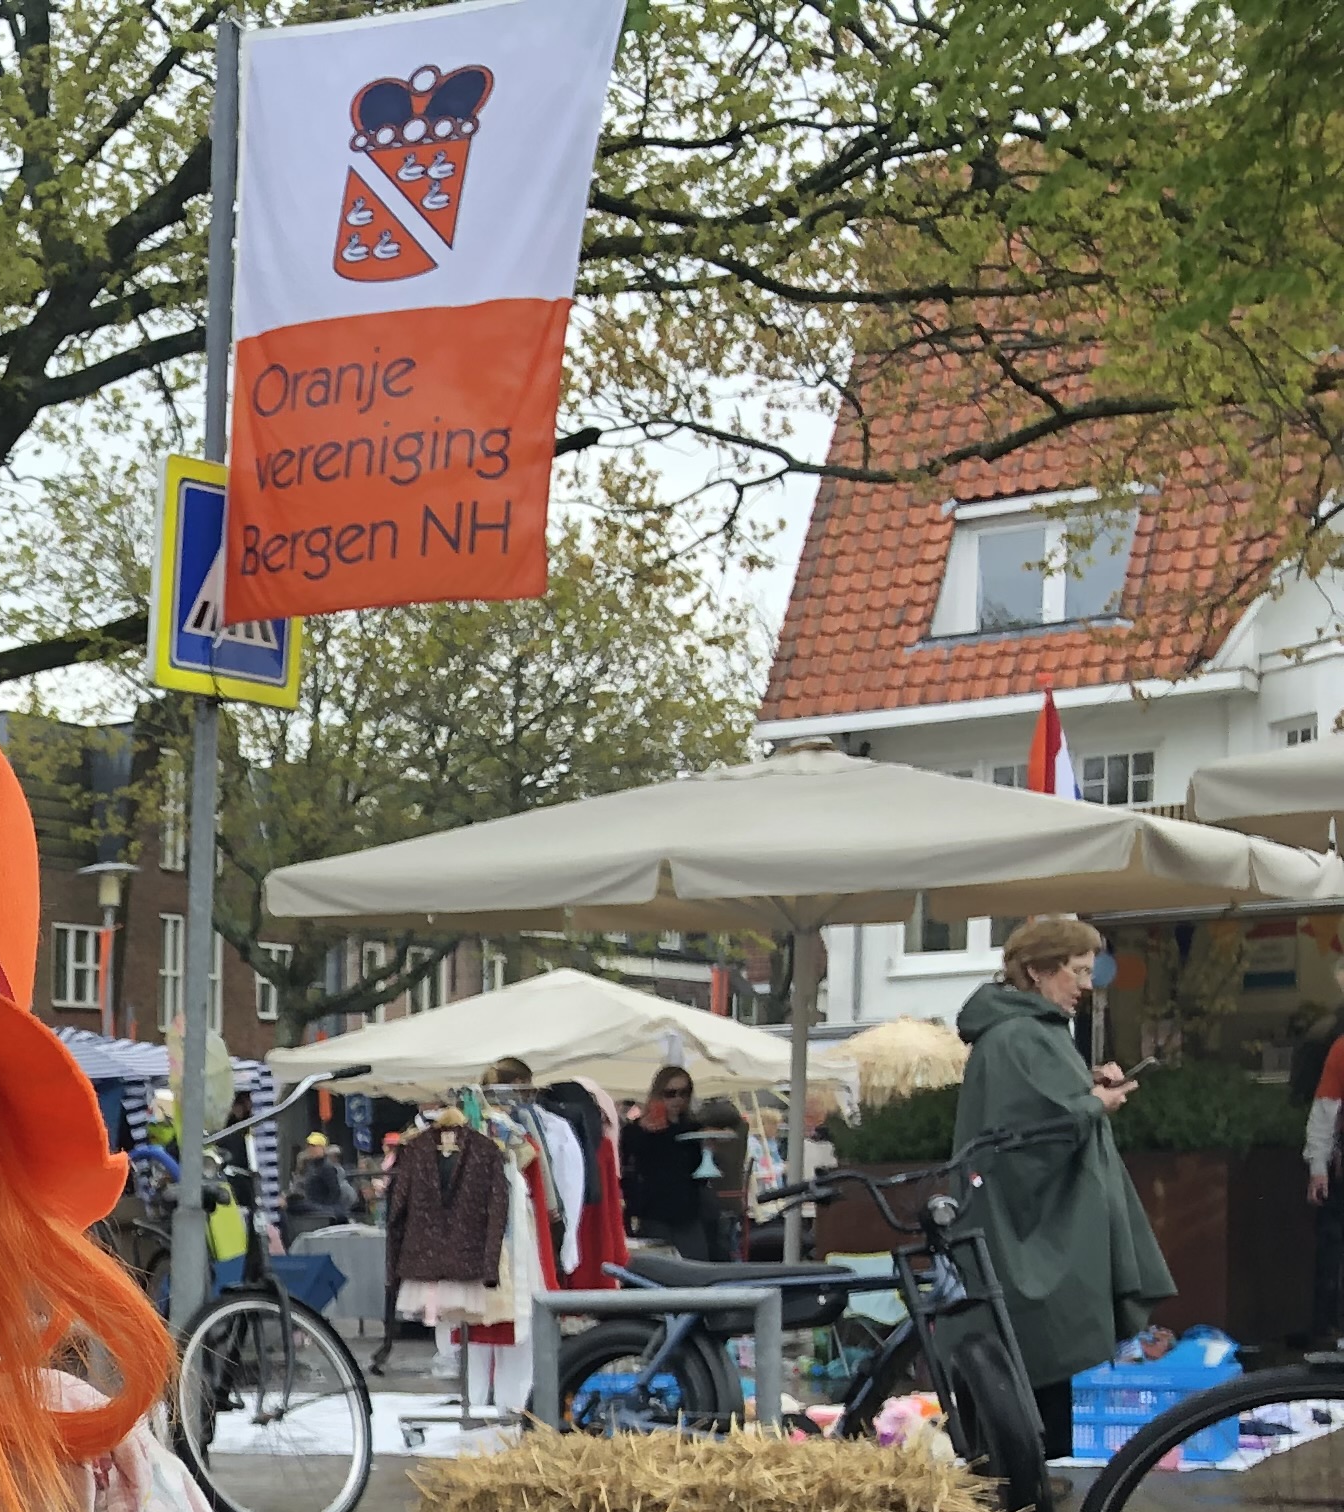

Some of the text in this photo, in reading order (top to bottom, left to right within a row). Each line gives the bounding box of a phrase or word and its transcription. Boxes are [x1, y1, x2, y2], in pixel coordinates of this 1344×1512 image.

[252, 346, 416, 417] Oranje
[255, 416, 511, 491] vereniging
[241, 500, 511, 580] Bergen NH
